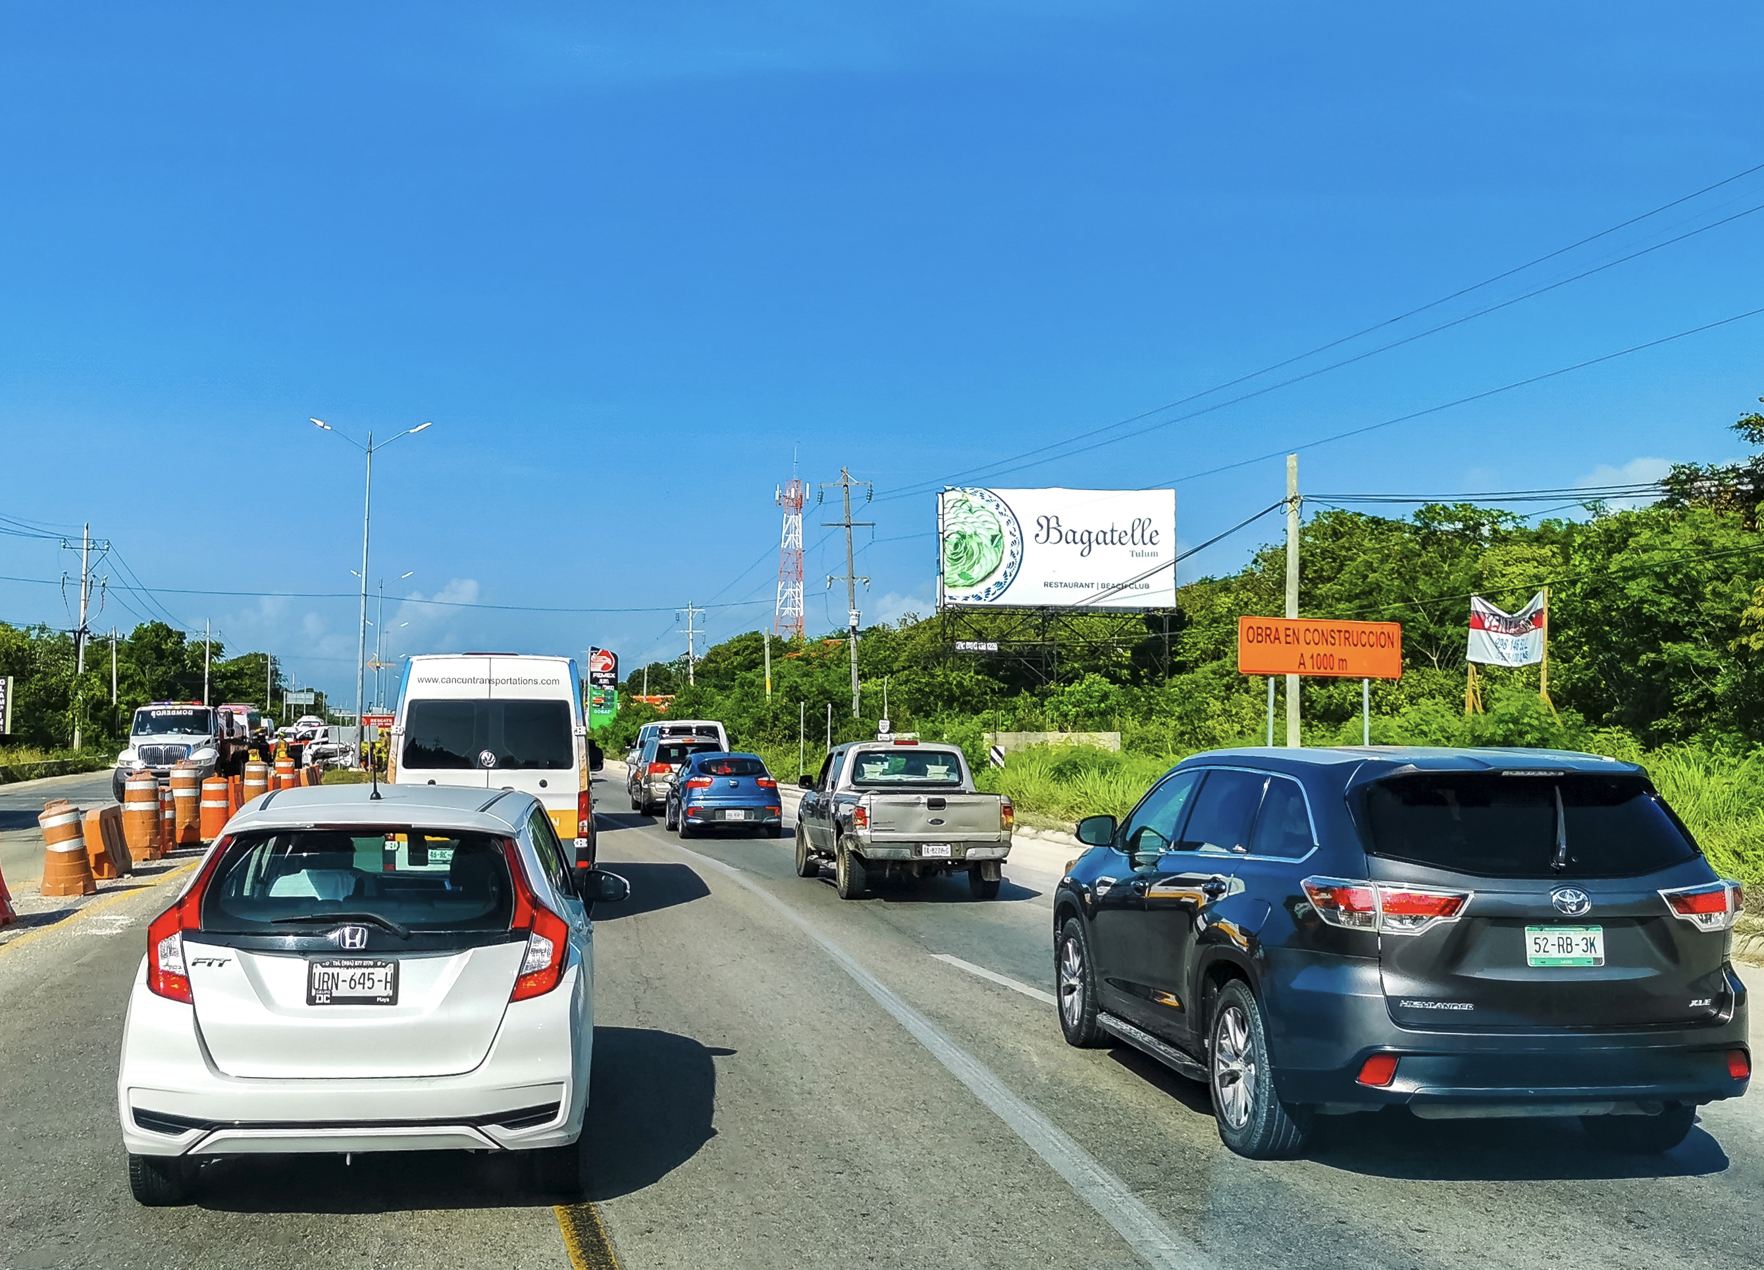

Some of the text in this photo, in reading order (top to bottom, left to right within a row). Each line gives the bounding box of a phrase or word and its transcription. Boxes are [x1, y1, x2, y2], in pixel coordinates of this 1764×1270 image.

[1034, 515, 1160, 557] Bagatelle
[1129, 550, 1159, 558] Tulum
[1043, 581, 1095, 590] RESTAURANT
[1246, 626, 1395, 648] OBRA EN CONSTRUCCIÓN
[1298, 653, 1348, 671] A 1000 m
[417, 675, 561, 687] www.cancuntransportations.com
[1533, 936, 1597, 954] 52-RB-3K
[191, 957, 232, 967] FIT
[313, 972, 393, 990] URN-645-H
[315, 994, 331, 1004] DC
[1688, 998, 1711, 1007] XLE
[1400, 1000, 1474, 1011] HIGHLANDER
